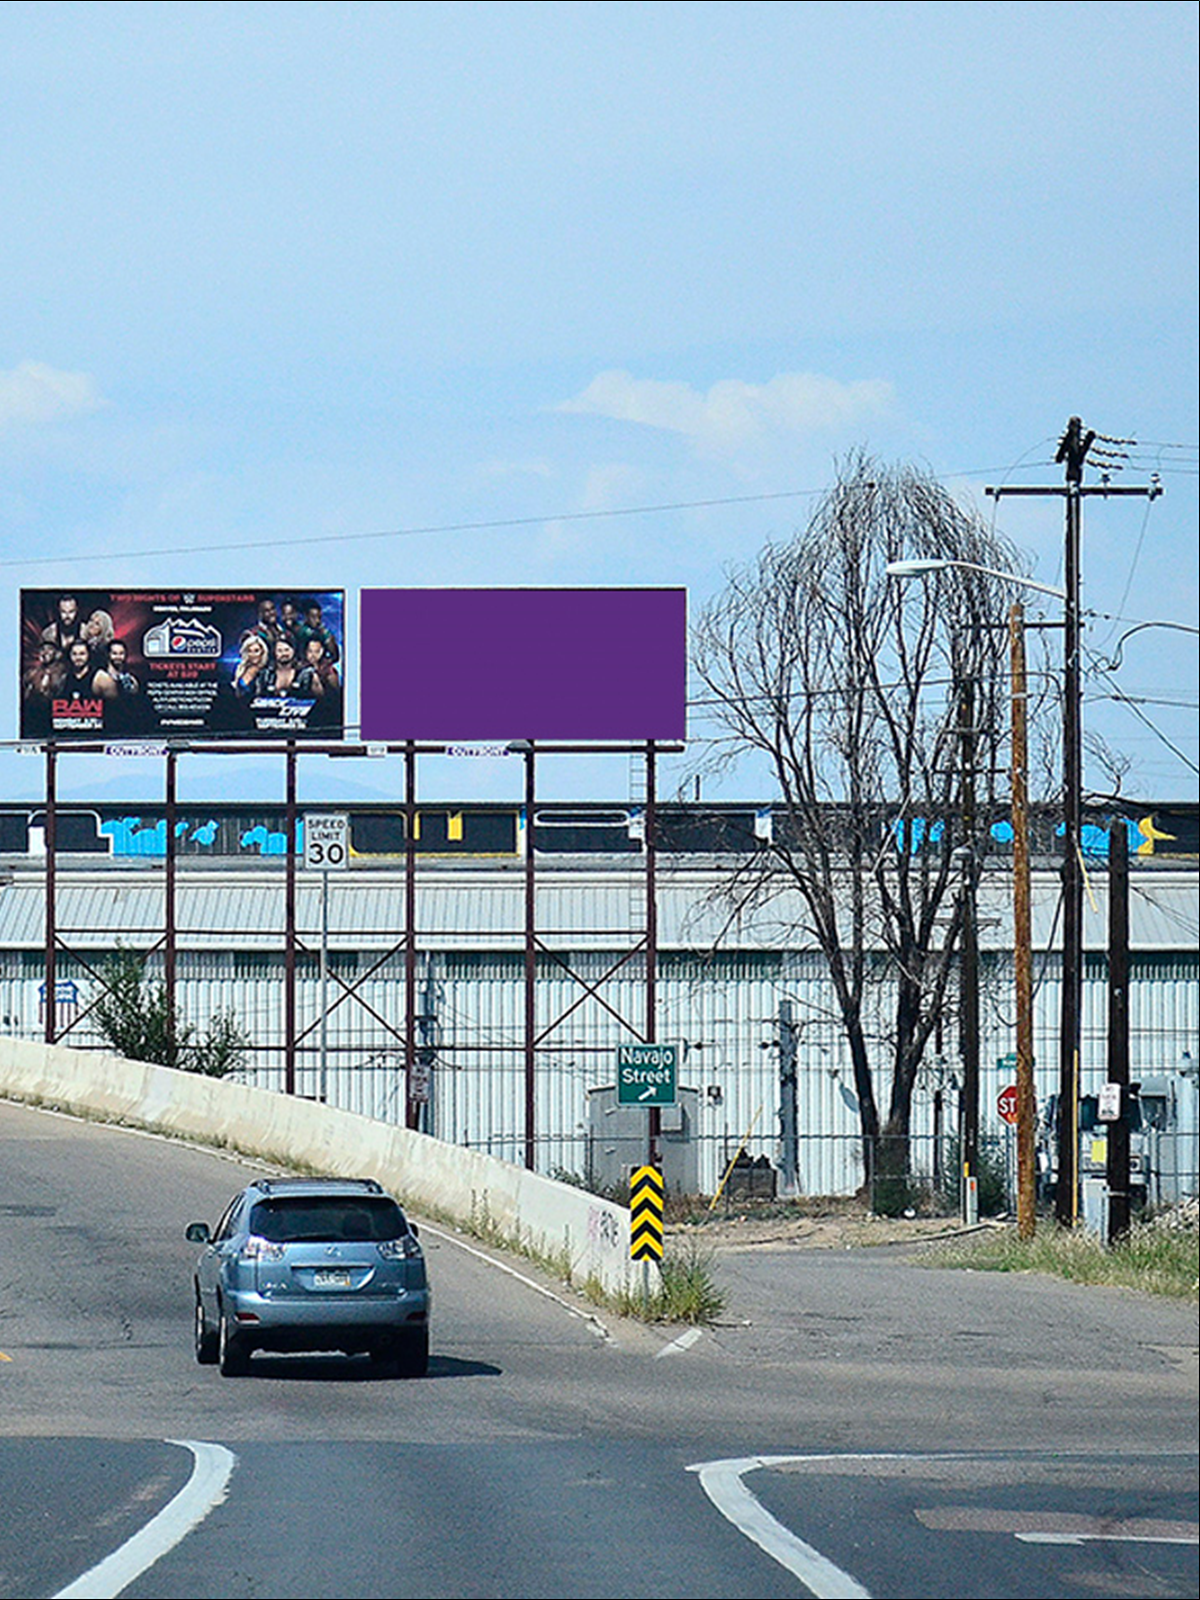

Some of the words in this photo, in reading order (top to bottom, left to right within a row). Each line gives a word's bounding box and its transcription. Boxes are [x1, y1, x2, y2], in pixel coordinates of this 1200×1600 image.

[52, 699, 103, 713] RAW
[307, 818, 346, 829] SPEED
[311, 831, 341, 840] LIMIT
[309, 842, 344, 865] 30
[620, 1046, 673, 1069] Navajo
[622, 1068, 671, 1084] Street
